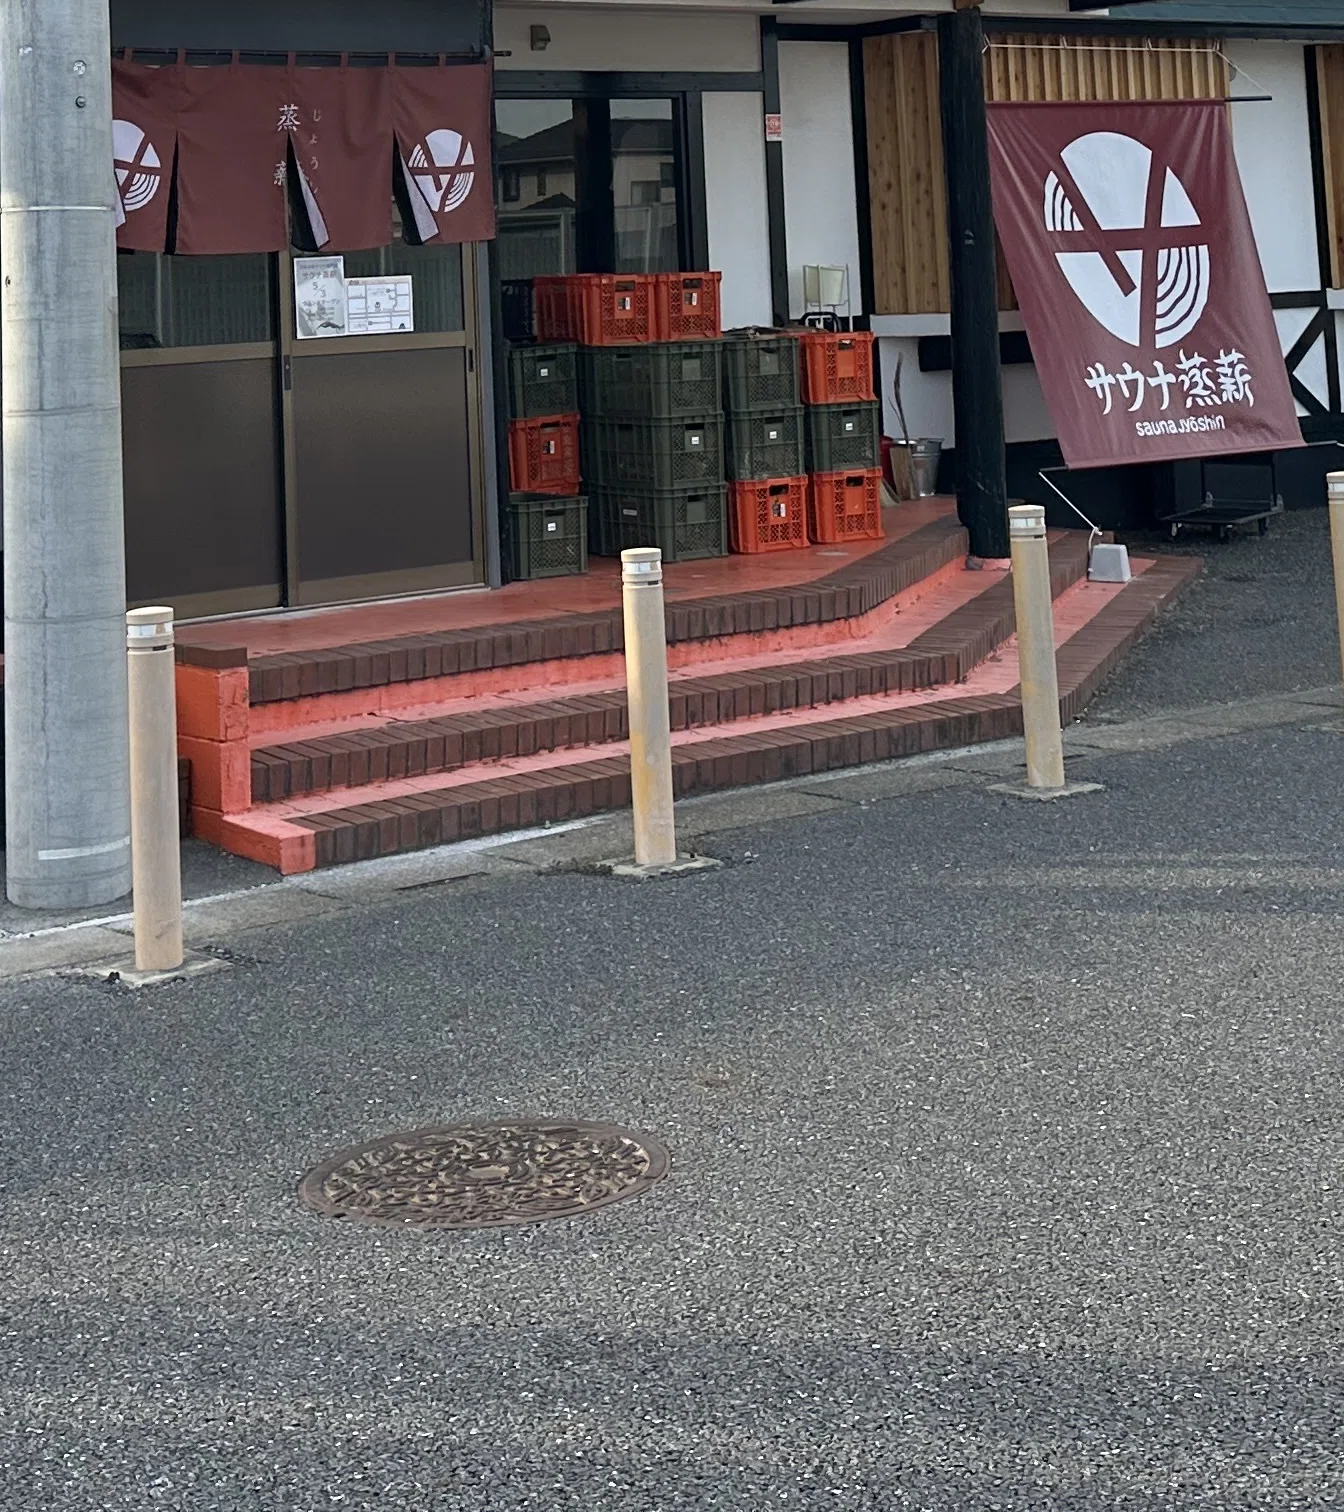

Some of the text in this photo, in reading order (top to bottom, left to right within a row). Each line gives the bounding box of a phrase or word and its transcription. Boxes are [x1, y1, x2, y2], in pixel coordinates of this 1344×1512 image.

[1084, 348, 1254, 415] サウナ蒸薪
[1135, 419, 1178, 437] sauna
